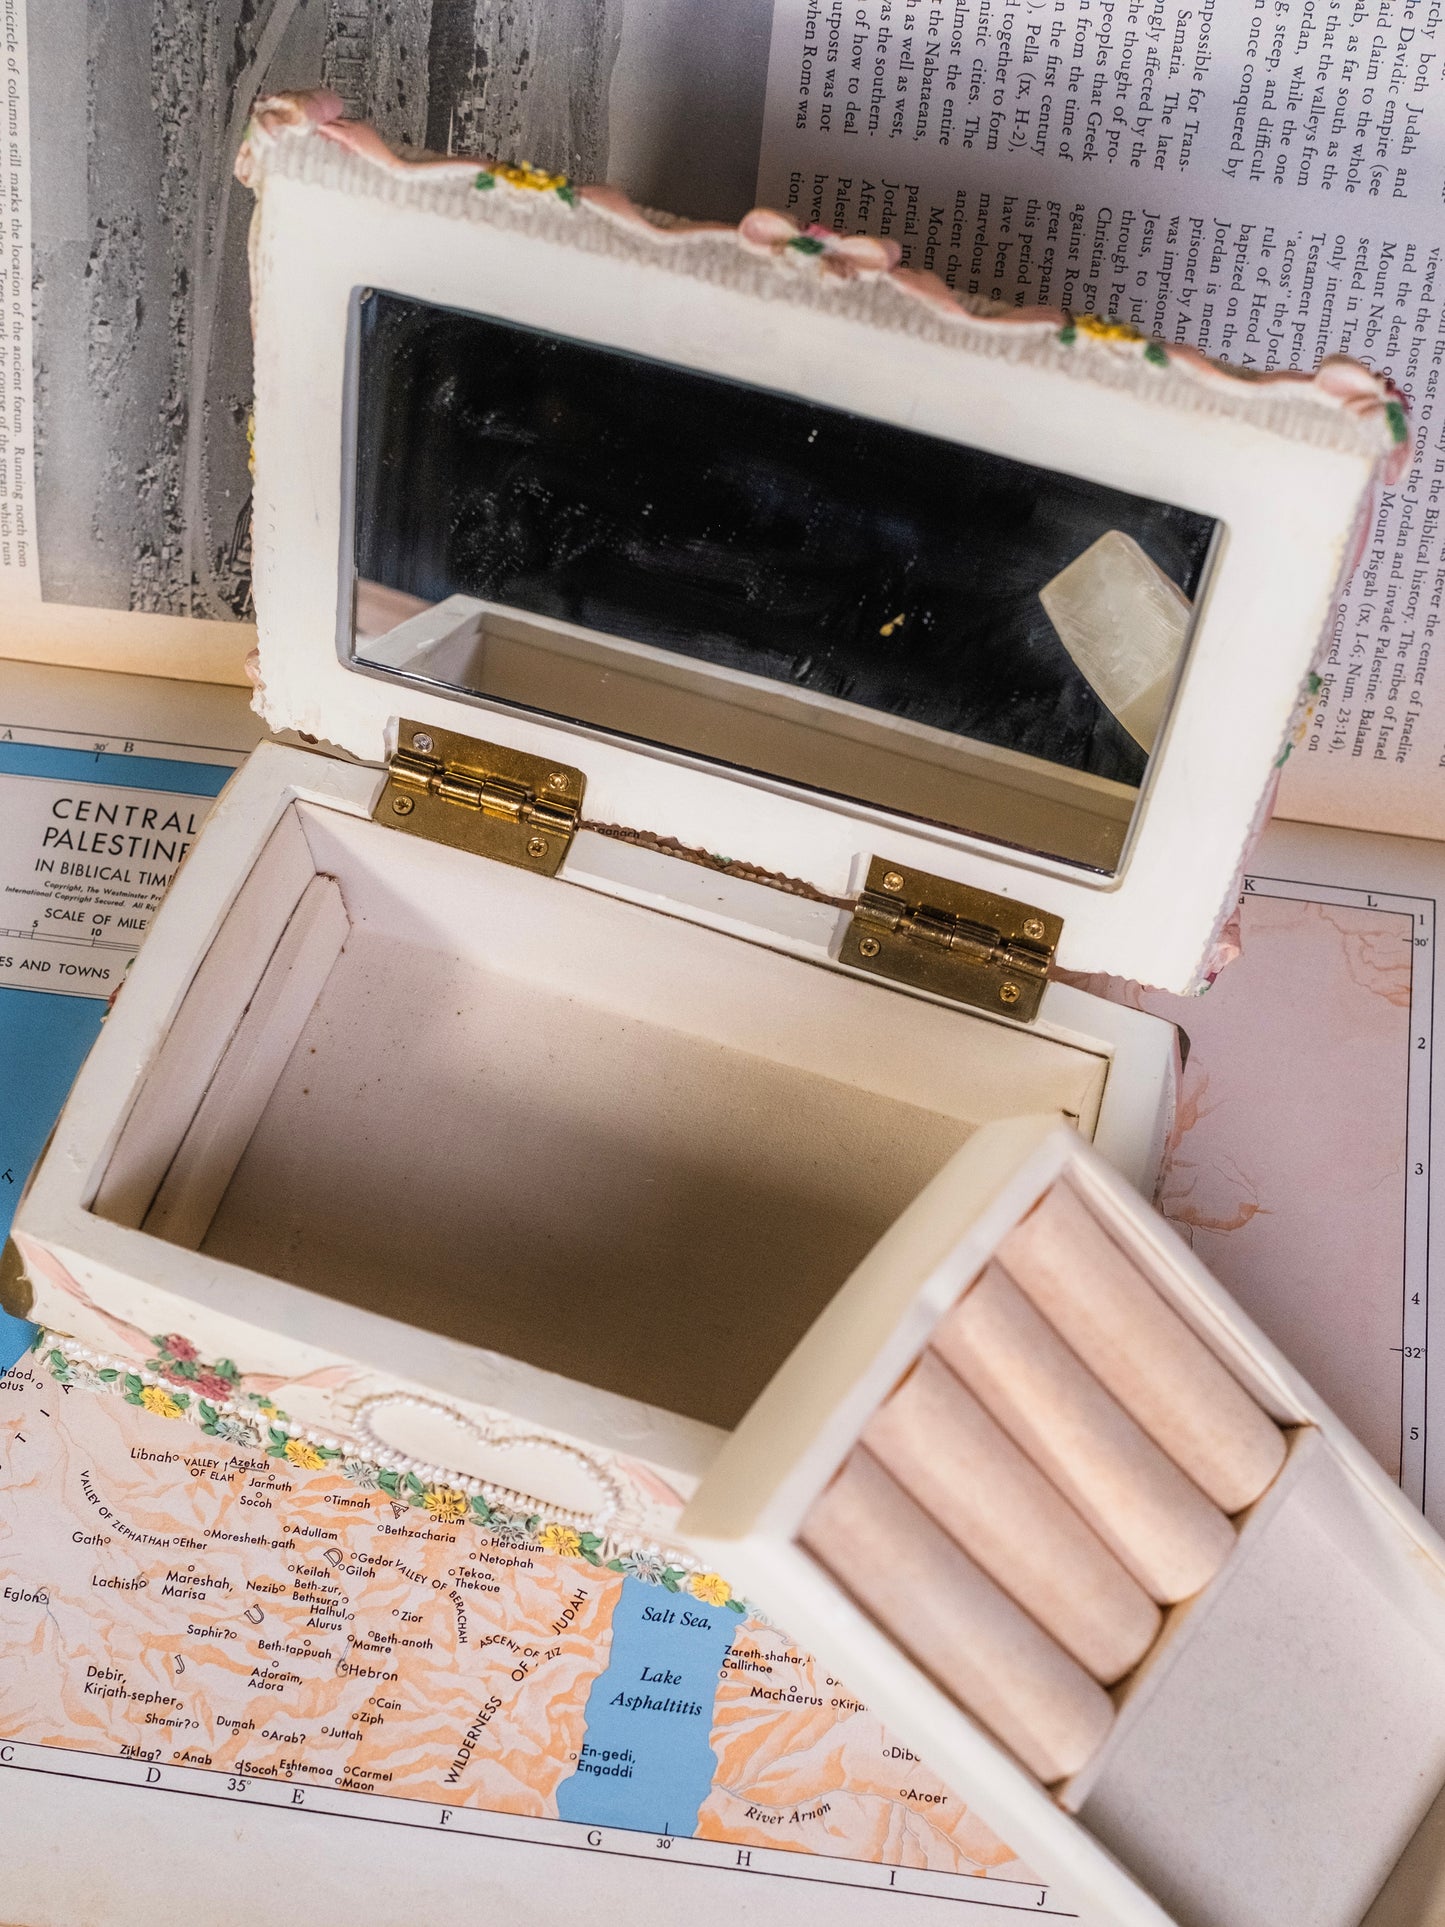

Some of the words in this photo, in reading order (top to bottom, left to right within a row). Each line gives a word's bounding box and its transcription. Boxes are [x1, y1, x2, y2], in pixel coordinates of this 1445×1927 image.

[856, 10, 870, 30] of
[1247, 17, 1262, 57] once
[851, 34, 868, 70] how
[1414, 54, 1436, 92] both
[848, 78, 860, 94] to
[1287, 66, 1305, 111] while
[8, 79, 20, 136] columns
[1230, 64, 1253, 151] conquered
[844, 102, 861, 134] deal
[1280, 120, 1297, 146] the
[1401, 103, 1424, 154] Judah
[10, 143, 21, 166] still
[1222, 158, 1243, 178] by
[1274, 154, 1287, 184] one
[1393, 168, 1407, 198] and
[11, 173, 22, 212] marks
[1261, 227, 1276, 257] rule
[1402, 244, 1416, 272] and
[1256, 267, 1270, 286] of
[1374, 242, 1397, 298] Mount
[1396, 282, 1412, 306] the
[1246, 294, 1267, 342] Herod
[1364, 304, 1384, 348] Nebo
[1386, 316, 1406, 356] death
[1397, 494, 1418, 546] Jordan
[1416, 508, 1439, 564] Biblical
[1391, 552, 1404, 579] and
[1402, 570, 1428, 619] history.
[1380, 584, 1396, 632] invade
[1398, 631, 1415, 658] The
[1365, 638, 1390, 702] Palestine.
[1388, 664, 1406, 700] tribes
[1384, 706, 1396, 722] of
[2, 730, 12, 739] A
[1352, 710, 1374, 756] Balaam
[124, 742, 134, 752] B
[1374, 726, 1394, 760] Israel
[52, 798, 196, 835] CENTRAL
[35, 858, 54, 872] IN
[60, 862, 130, 883] BIBLICAL
[104, 888, 148, 899] Westminster
[1244, 879, 1255, 891] K
[55, 892, 92, 903] Copyright
[1368, 895, 1377, 907] L
[32, 920, 38, 928] 5
[44, 908, 85, 922] SCALE
[92, 914, 112, 925] OF
[118, 917, 149, 930] MILE
[91, 928, 102, 936] 10
[20, 960, 51, 972] AND
[59, 963, 110, 979] TOWNS
[1418, 1037, 1425, 1049] 2
[1415, 1163, 1423, 1175] 3
[1411, 1292, 1420, 1305] 4
[1410, 1427, 1418, 1440] 5
[131, 1448, 172, 1463] Libnah
[184, 1458, 219, 1468] VALLEY
[229, 1456, 270, 1470] Azekah
[190, 1468, 206, 1476] OF
[210, 1471, 234, 1481] ELAH
[249, 1479, 292, 1492] Jarmuth
[81, 1470, 100, 1504] VALLEY
[99, 1507, 113, 1519] OF
[112, 1520, 170, 1547] ZEPHATHAH
[240, 1495, 272, 1508] Socoh
[333, 1495, 370, 1508] Timnah
[72, 1532, 103, 1546] Gath
[211, 1528, 296, 1549] Moresheth-gath
[292, 1526, 337, 1540] Adullam
[385, 1525, 456, 1543] Bethzacharia
[180, 1538, 207, 1550] Ether
[491, 1538, 544, 1552] Herodium
[357, 1553, 393, 1568] Gedor
[480, 1552, 533, 1568] Netophah
[296, 1565, 330, 1578] Keilah
[346, 1565, 375, 1578] Giloh
[458, 1567, 494, 1582] Tekoa,
[92, 1575, 138, 1590] Lachish
[166, 1570, 233, 1592] Mareshah,
[246, 1580, 278, 1594] Nezib
[293, 1579, 341, 1597] Beth-zur,
[456, 1578, 500, 1592] Thekoue
[4, 1587, 40, 1603] Eglon
[162, 1585, 206, 1600] Marisa
[292, 1591, 339, 1607] Bethsura
[396, 1559, 428, 1584] VALLEY
[432, 1580, 447, 1590] OF
[449, 1590, 468, 1643] BERACHAH
[310, 1604, 348, 1620] Halhul,
[401, 1611, 423, 1622] Zior
[642, 1607, 676, 1624] Salt
[680, 1612, 711, 1630] Sea,
[187, 1624, 230, 1639] Saphir?
[306, 1618, 342, 1630] Alurus
[258, 1640, 331, 1659] Beth-tappuah
[352, 1639, 391, 1653] Mamre
[374, 1633, 433, 1652] Beth-anoth
[480, 1635, 520, 1653] ASCENT
[524, 1648, 540, 1657] OF
[544, 1647, 561, 1660] ZIZ
[722, 1645, 805, 1670] Zareth-shahar,
[349, 1664, 398, 1681] Hebron
[721, 1658, 772, 1675] Callirhoe
[87, 1666, 126, 1686] Debir,
[251, 1665, 302, 1686] Adoraim,
[640, 1667, 682, 1685] Lake
[248, 1678, 284, 1691] Adora
[444, 1696, 502, 1782] WILDERNESS
[512, 1661, 528, 1681] OF
[552, 1588, 588, 1636] JUDAH
[84, 1682, 176, 1706] Kirjath-sepher
[750, 1686, 822, 1706] Machaerus
[376, 1698, 401, 1710] Cain
[610, 1692, 702, 1715] Asphaltitis
[145, 1713, 190, 1728] Shamir?
[217, 1716, 255, 1730] Dumah
[360, 1712, 384, 1725] Ziph
[269, 1731, 306, 1744] Arab?
[329, 1728, 362, 1741] Juttah
[0, 1746, 14, 1761] C
[119, 1744, 162, 1761] Ziklag?
[181, 1752, 212, 1765] Anab
[582, 1744, 635, 1764] En-gedi,
[146, 1767, 161, 1782] D
[244, 1762, 278, 1776] Socoh
[280, 1759, 333, 1776] Eshtemoa
[352, 1766, 392, 1781] Carmel
[577, 1759, 633, 1778] Engaddi
[341, 1778, 374, 1792] Maon
[291, 1789, 304, 1804] E
[907, 1789, 948, 1804] Aroer
[440, 1810, 452, 1824] F
[744, 1804, 784, 1824] River
[789, 1804, 831, 1823] Arnon
[588, 1831, 602, 1846] G
[736, 1850, 751, 1866] H
[1037, 1891, 1046, 1906] J
